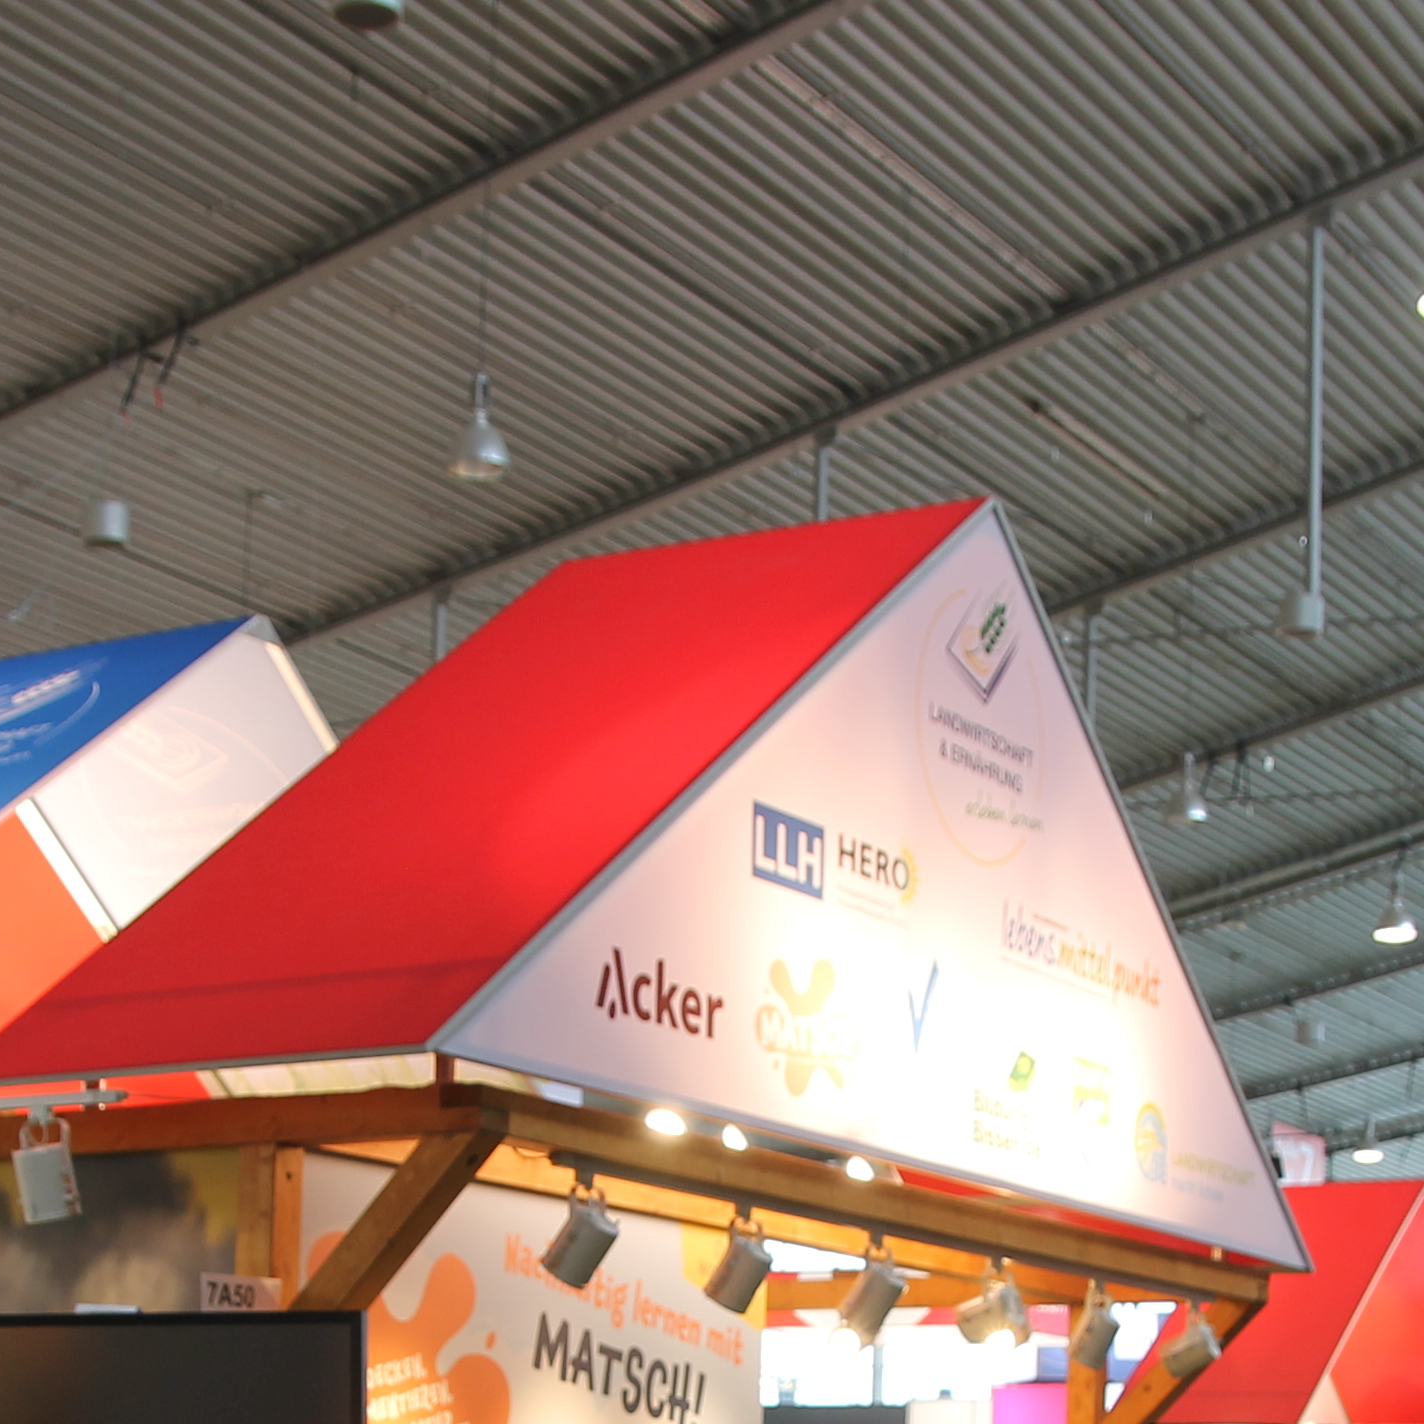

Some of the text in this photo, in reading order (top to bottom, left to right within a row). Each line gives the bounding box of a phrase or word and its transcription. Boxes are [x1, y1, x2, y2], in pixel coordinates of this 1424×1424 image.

[755, 814, 911, 891] LLH HERO
[595, 946, 724, 1039] Acker
[207, 1281, 256, 1308] 7A50
